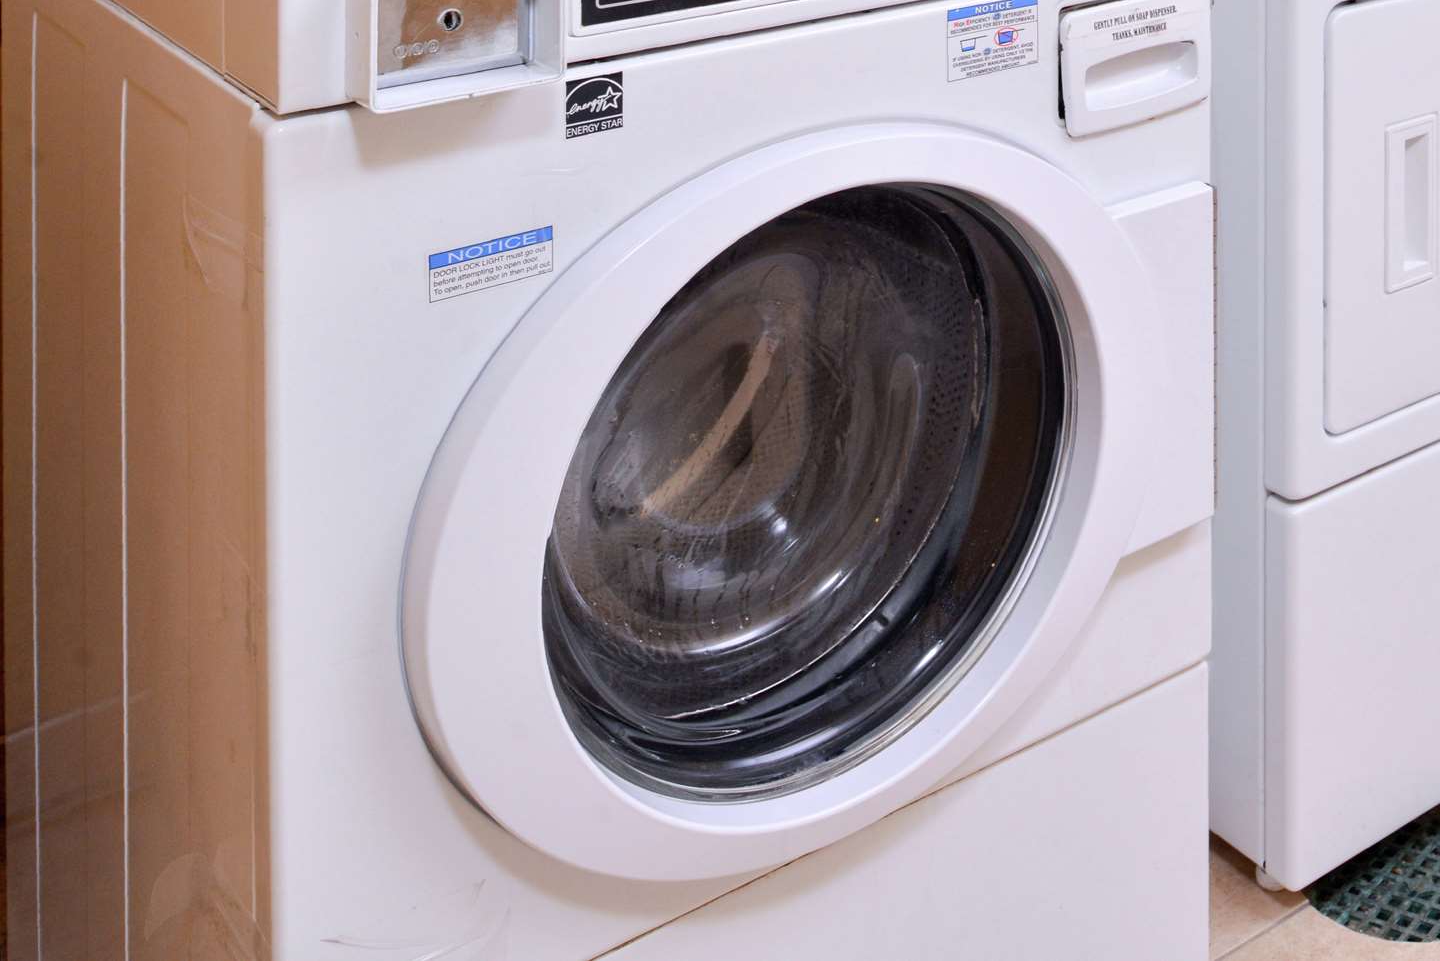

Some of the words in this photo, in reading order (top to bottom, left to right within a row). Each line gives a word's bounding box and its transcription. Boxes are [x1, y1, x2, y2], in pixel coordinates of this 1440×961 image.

[975, 1, 1012, 14] NOTICE
[1094, 20, 1113, 31] GENTLY
[1114, 17, 1127, 26] PULL
[1128, 14, 1135, 22] ON
[1136, 12, 1149, 21] SOAP
[1134, 22, 1168, 37] MAINTENANCE
[567, 122, 600, 137] ENERGY
[601, 118, 623, 130] STAR
[448, 232, 536, 263] NOTICE
[433, 267, 457, 279] DOOR
[460, 262, 480, 272] LOCK
[482, 256, 504, 267] LIGHT
[505, 251, 524, 261] must
[524, 249, 533, 258] go
[433, 276, 456, 287] before
[457, 268, 494, 281] attempting
[503, 261, 521, 270] open
[434, 288, 443, 296] To
[465, 279, 483, 289] push
[484, 274, 500, 283] door
[509, 268, 525, 277] then
[526, 264, 537, 274] pull
